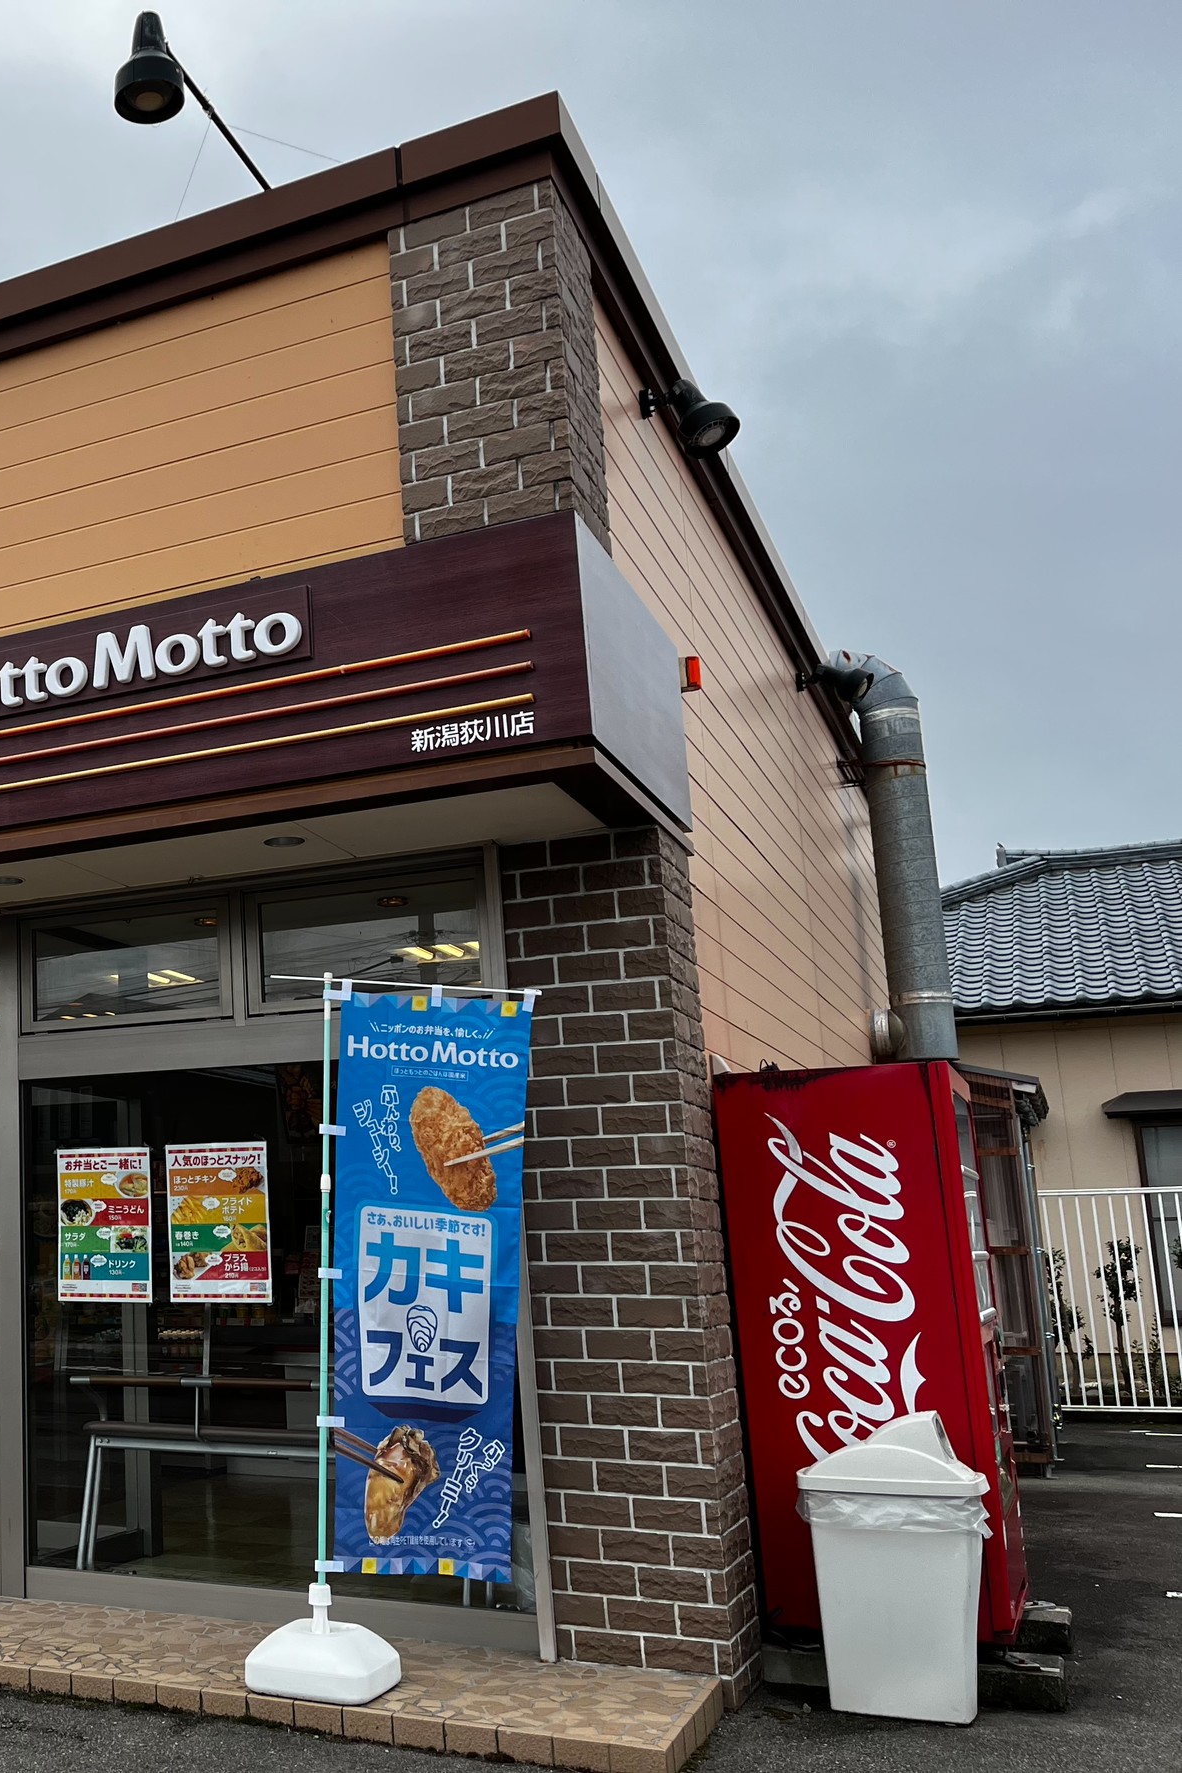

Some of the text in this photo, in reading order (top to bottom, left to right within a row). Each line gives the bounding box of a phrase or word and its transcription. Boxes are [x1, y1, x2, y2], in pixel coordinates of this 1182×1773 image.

[411, 711, 535, 753] 新潟荻川店
[65, 1158, 142, 1171] お弁当とご一緒に!
[171, 1154, 261, 1167] 人気のほっとスナック!
[173, 1175, 217, 1184] ほっとチキン
[221, 1197, 253, 1206] フライド
[108, 1205, 145, 1214] ミニうどん
[222, 1206, 245, 1215] ポテト
[367, 1212, 486, 1237] さあ、おいしい季節です!
[64, 1232, 86, 1241] サラダ
[108, 1260, 136, 1269] ドリンク
[365, 1231, 484, 1314] カキ
[367, 1330, 483, 1398] フェス
